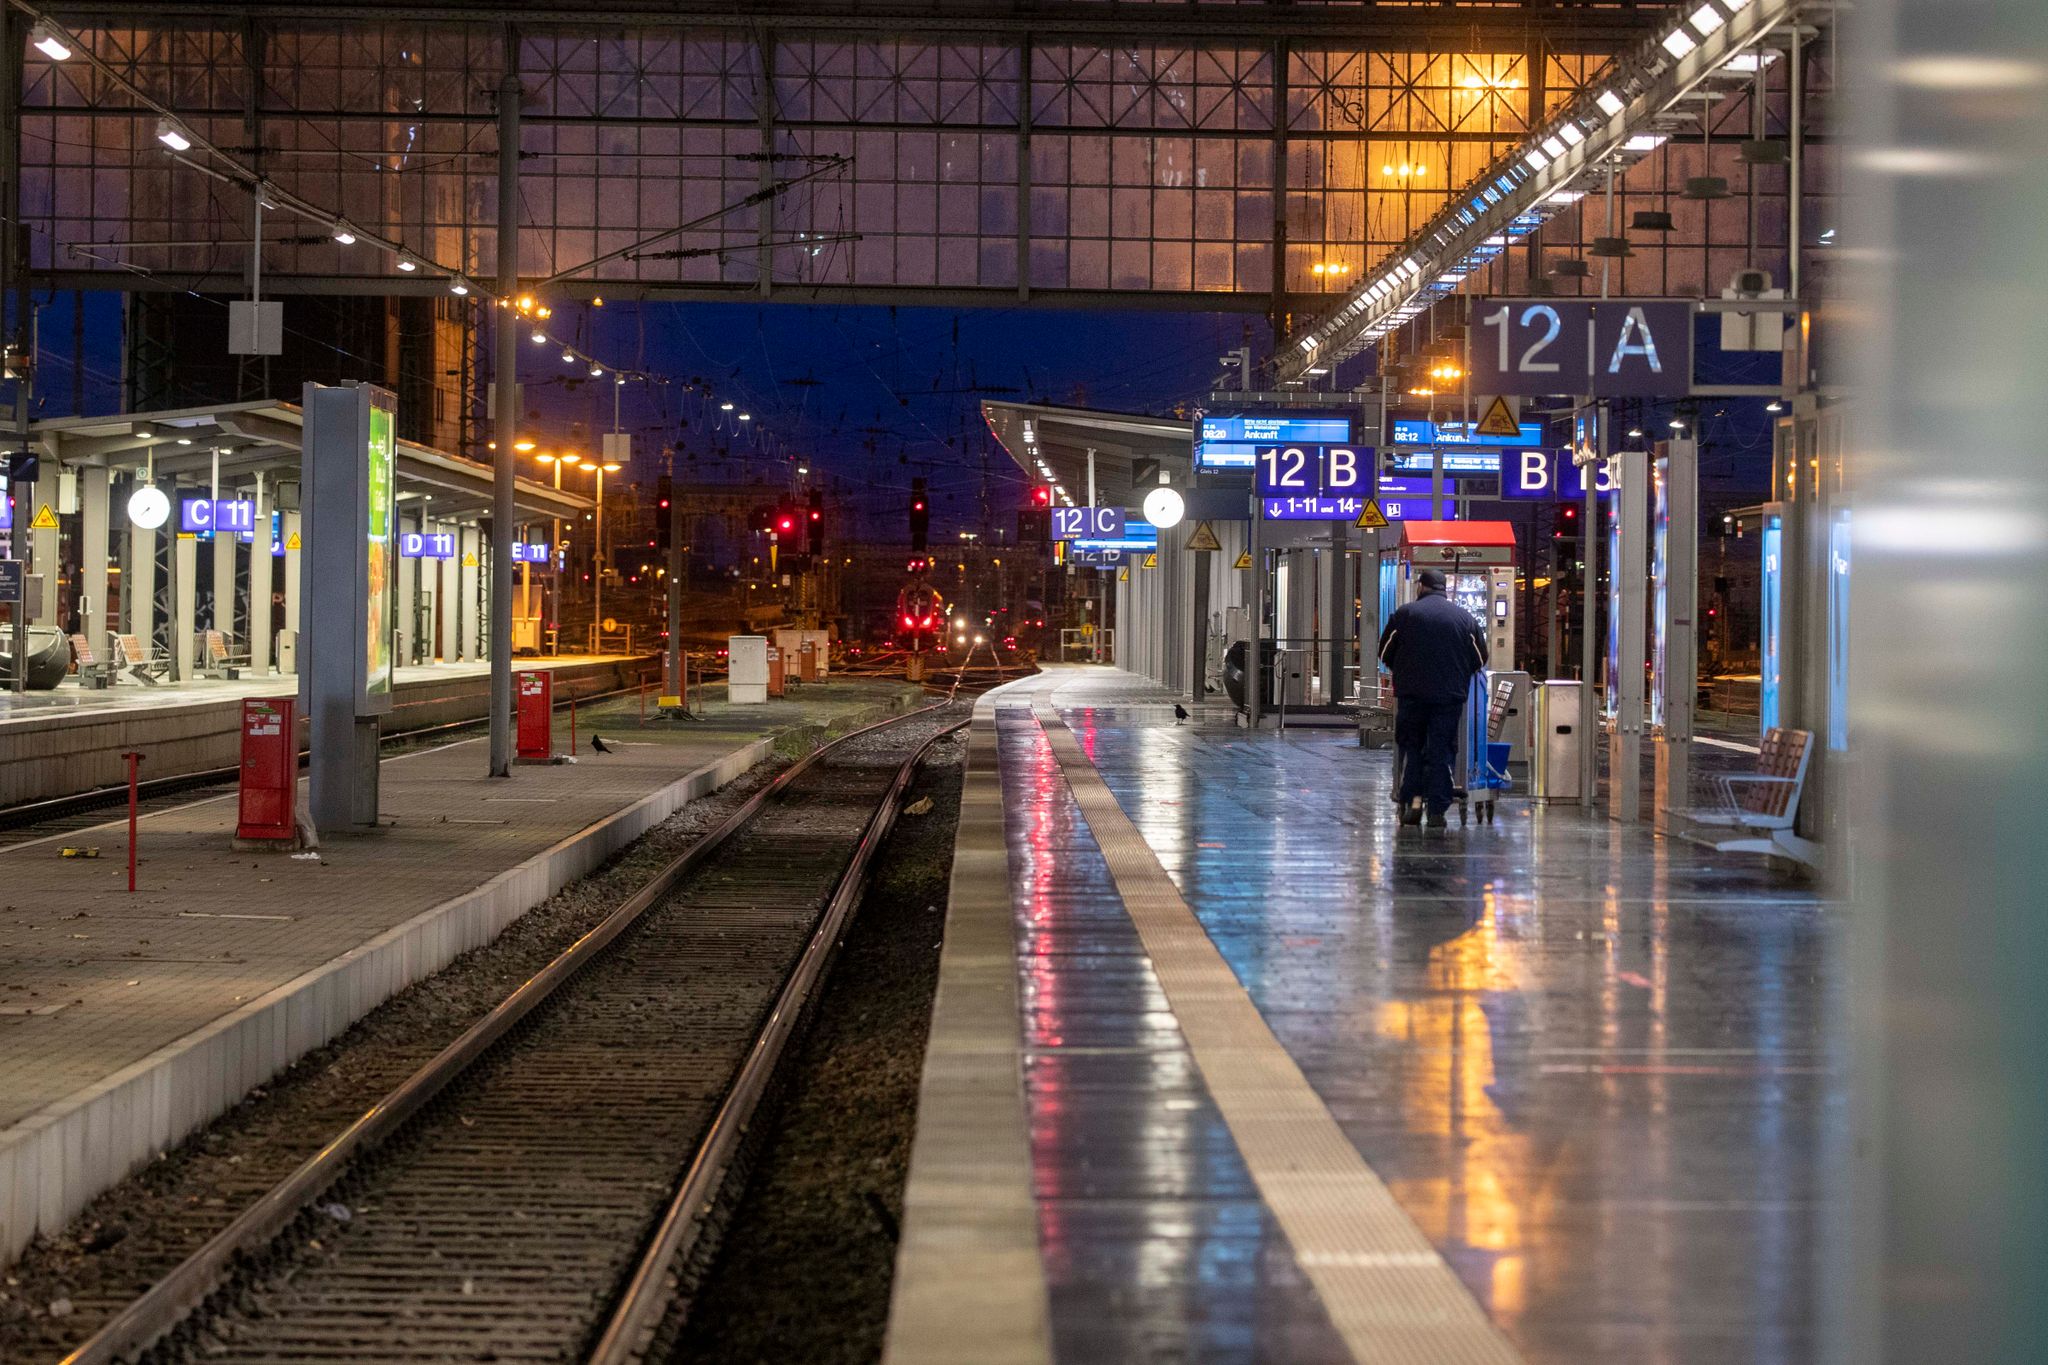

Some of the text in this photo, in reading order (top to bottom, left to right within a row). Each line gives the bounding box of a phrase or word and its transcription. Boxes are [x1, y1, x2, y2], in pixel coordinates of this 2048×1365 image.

[1483, 305, 1662, 373] 12 A
[1203, 430, 1226, 439] 08:20
[1244, 430, 1278, 439] Ankunft
[1394, 432, 1418, 442] 08:12
[1436, 433, 1470, 442] Ankunt
[1262, 448, 1357, 487] 12 B
[1521, 452, 1548, 490] B
[191, 499, 249, 526] C 11
[1287, 498, 1317, 513] 1-11
[1056, 508, 1115, 533] 12 C
[407, 534, 450, 553] D 11
[512, 542, 545, 559] E 11
